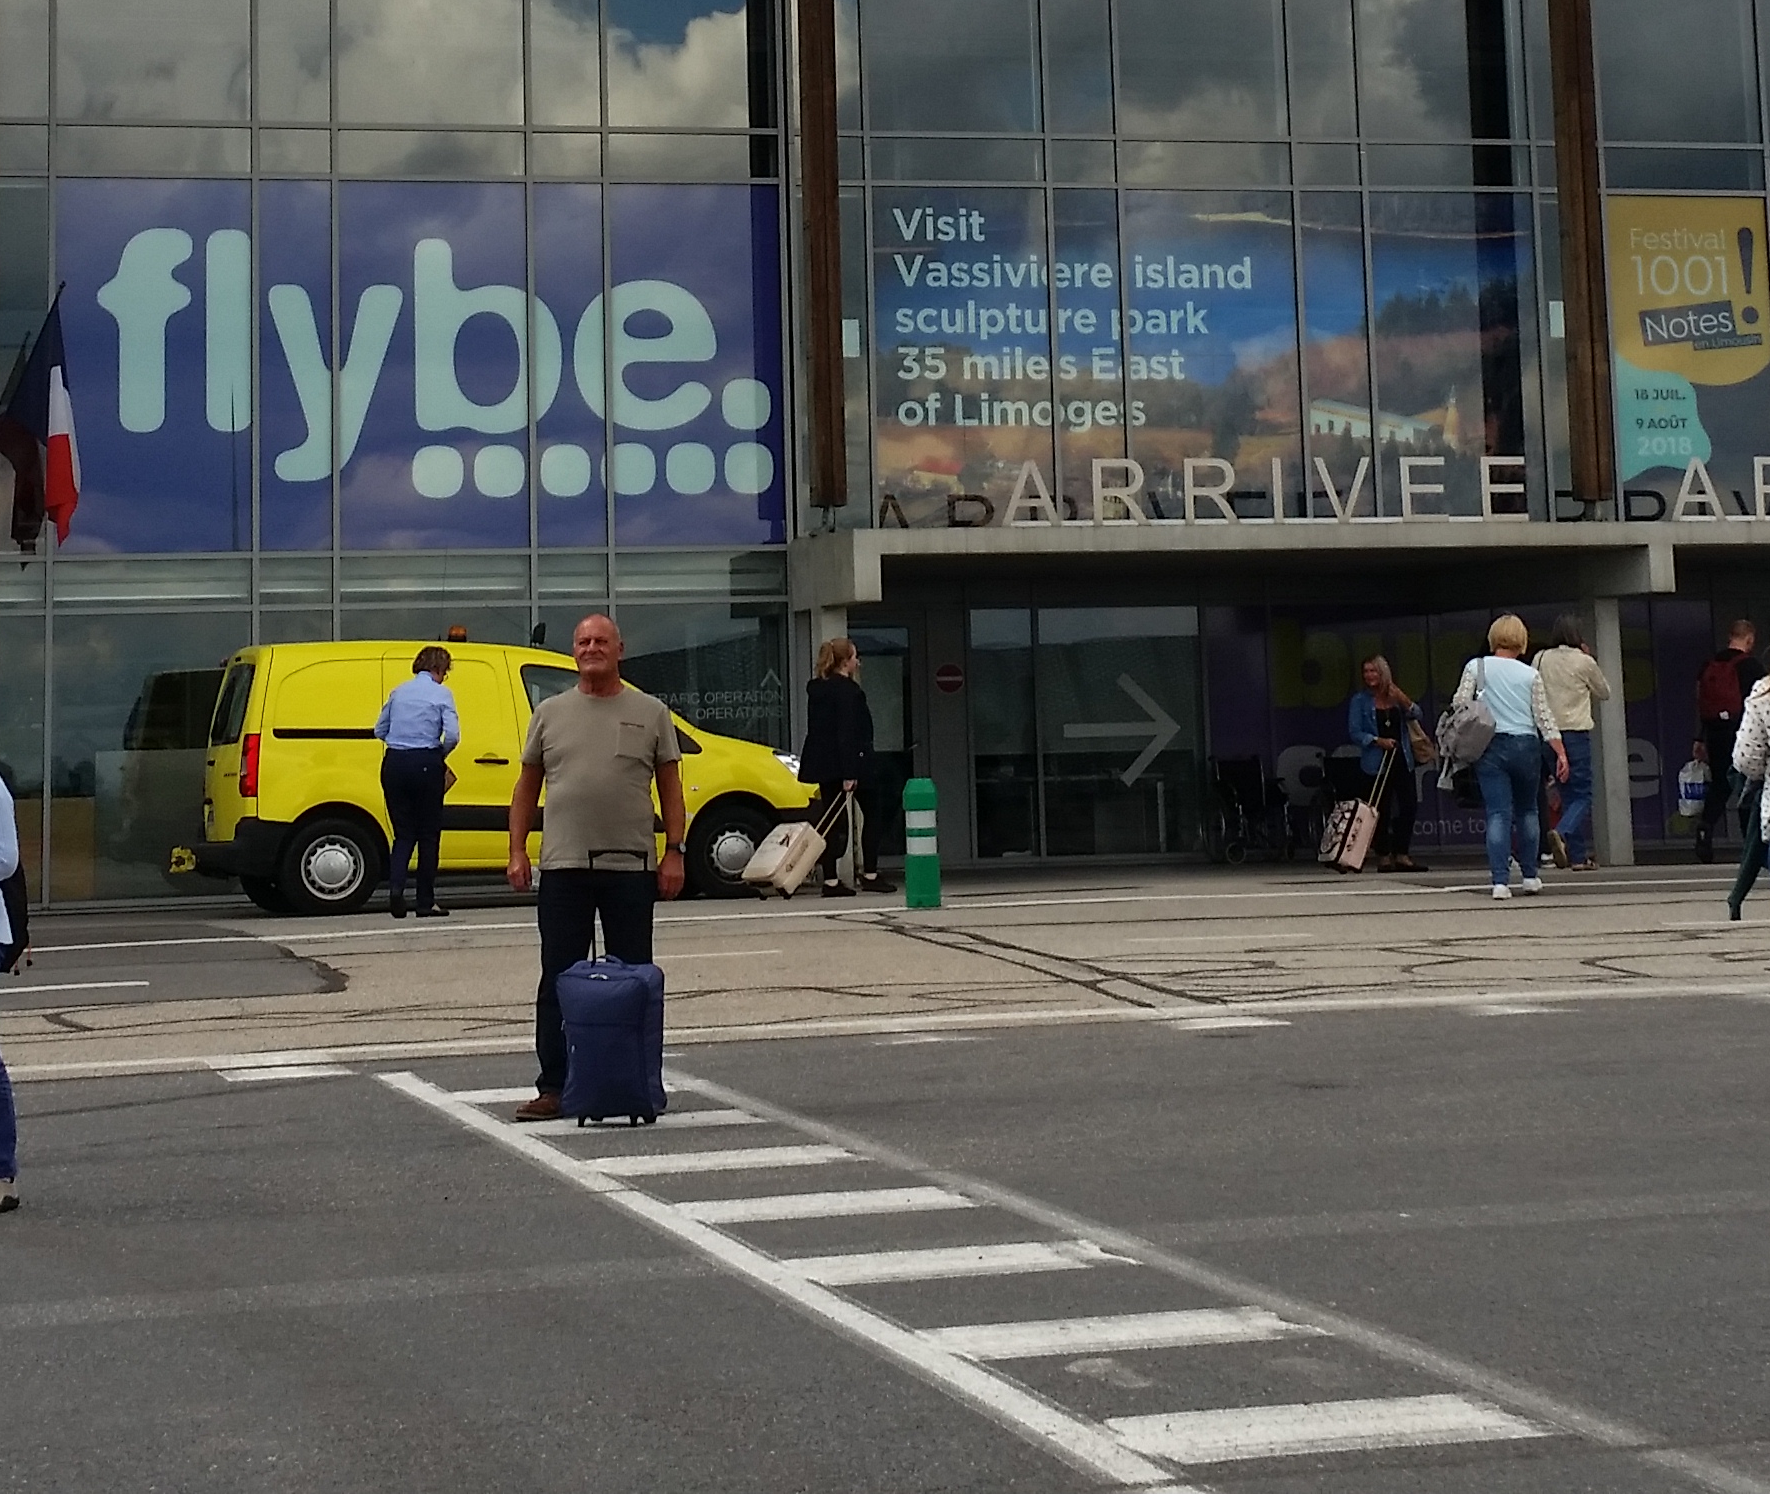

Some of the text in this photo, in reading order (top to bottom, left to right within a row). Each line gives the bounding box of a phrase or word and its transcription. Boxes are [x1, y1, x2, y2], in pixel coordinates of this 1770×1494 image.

[891, 207, 986, 242] Visit
[1629, 228, 1727, 251] Festival
[1134, 255, 1253, 290] island
[1631, 254, 1728, 296] 1001
[895, 299, 1210, 341] sculpture park
[1643, 310, 1734, 343] Notes
[897, 346, 1186, 381] 35 miles East
[897, 392, 1147, 434] of Limoges
[1635, 414, 1688, 430] 9 AOÛT
[1637, 435, 1694, 457] 2018
[1000, 455, 1530, 527] ARRIVEE
[695, 706, 783, 720] OPERATIONS
[704, 690, 784, 705] OPERATION
